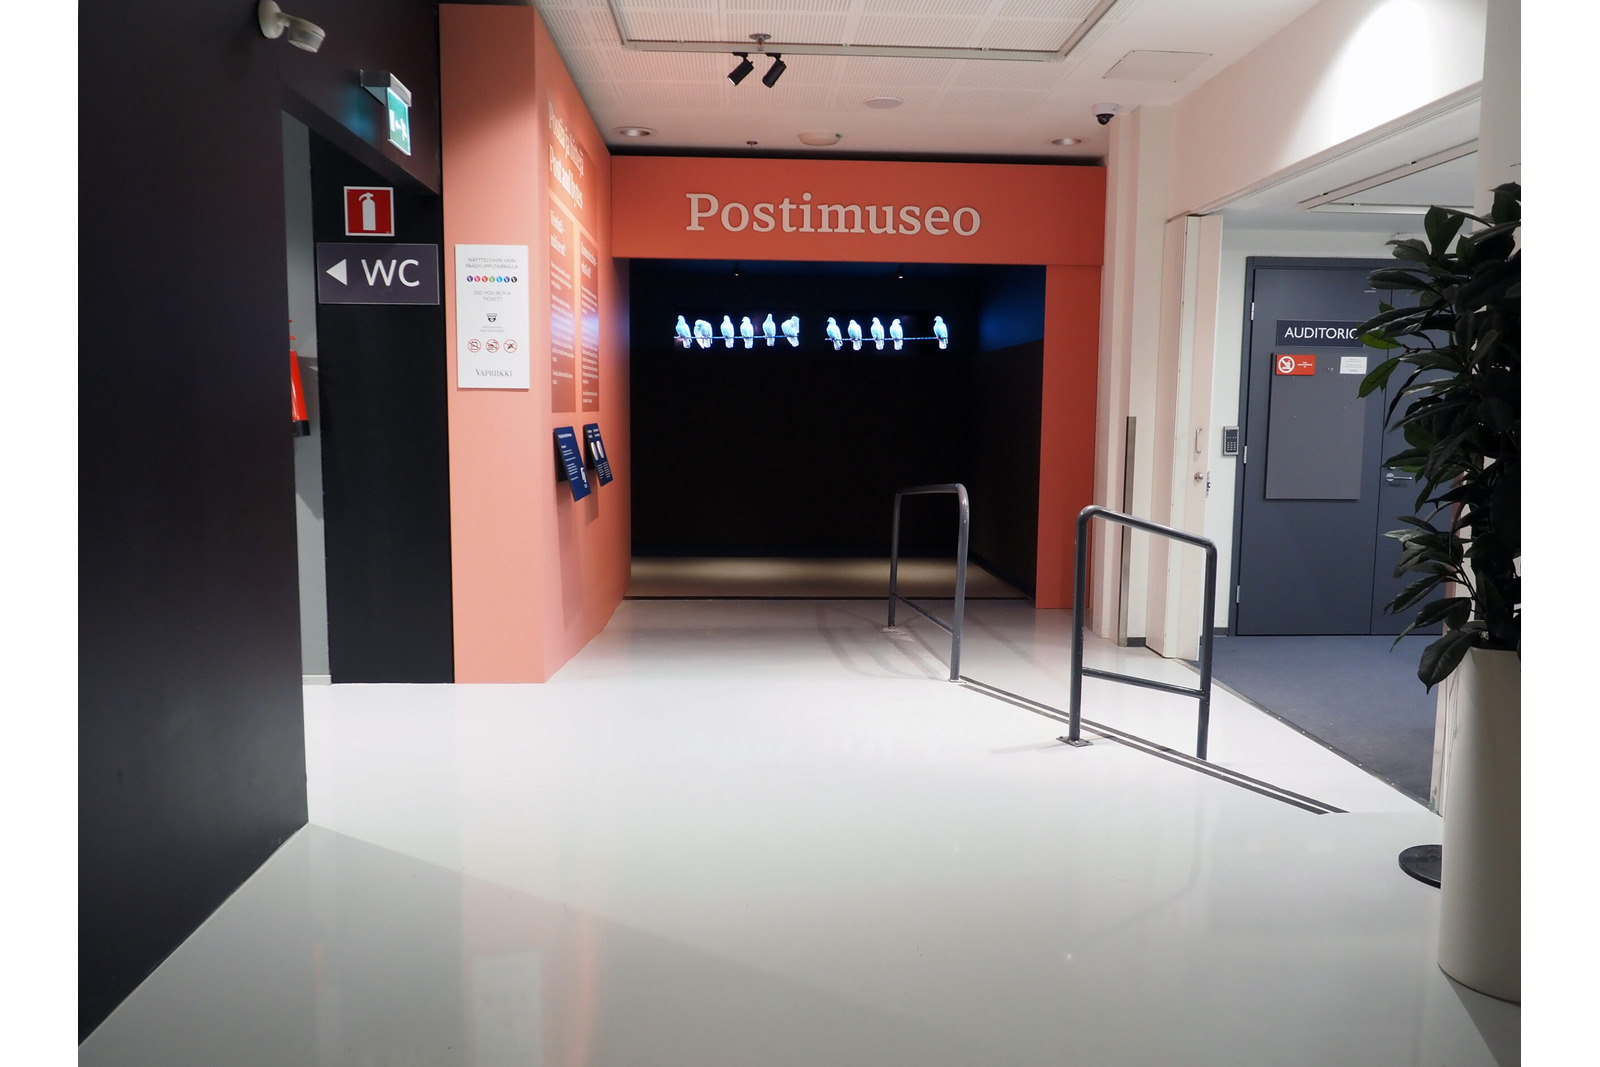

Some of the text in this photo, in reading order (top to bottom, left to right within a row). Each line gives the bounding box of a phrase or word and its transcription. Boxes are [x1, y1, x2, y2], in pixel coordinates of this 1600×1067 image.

[685, 192, 981, 236] Postimuseo
[361, 259, 420, 287] WC
[475, 368, 513, 377] VAPRIIKKI
